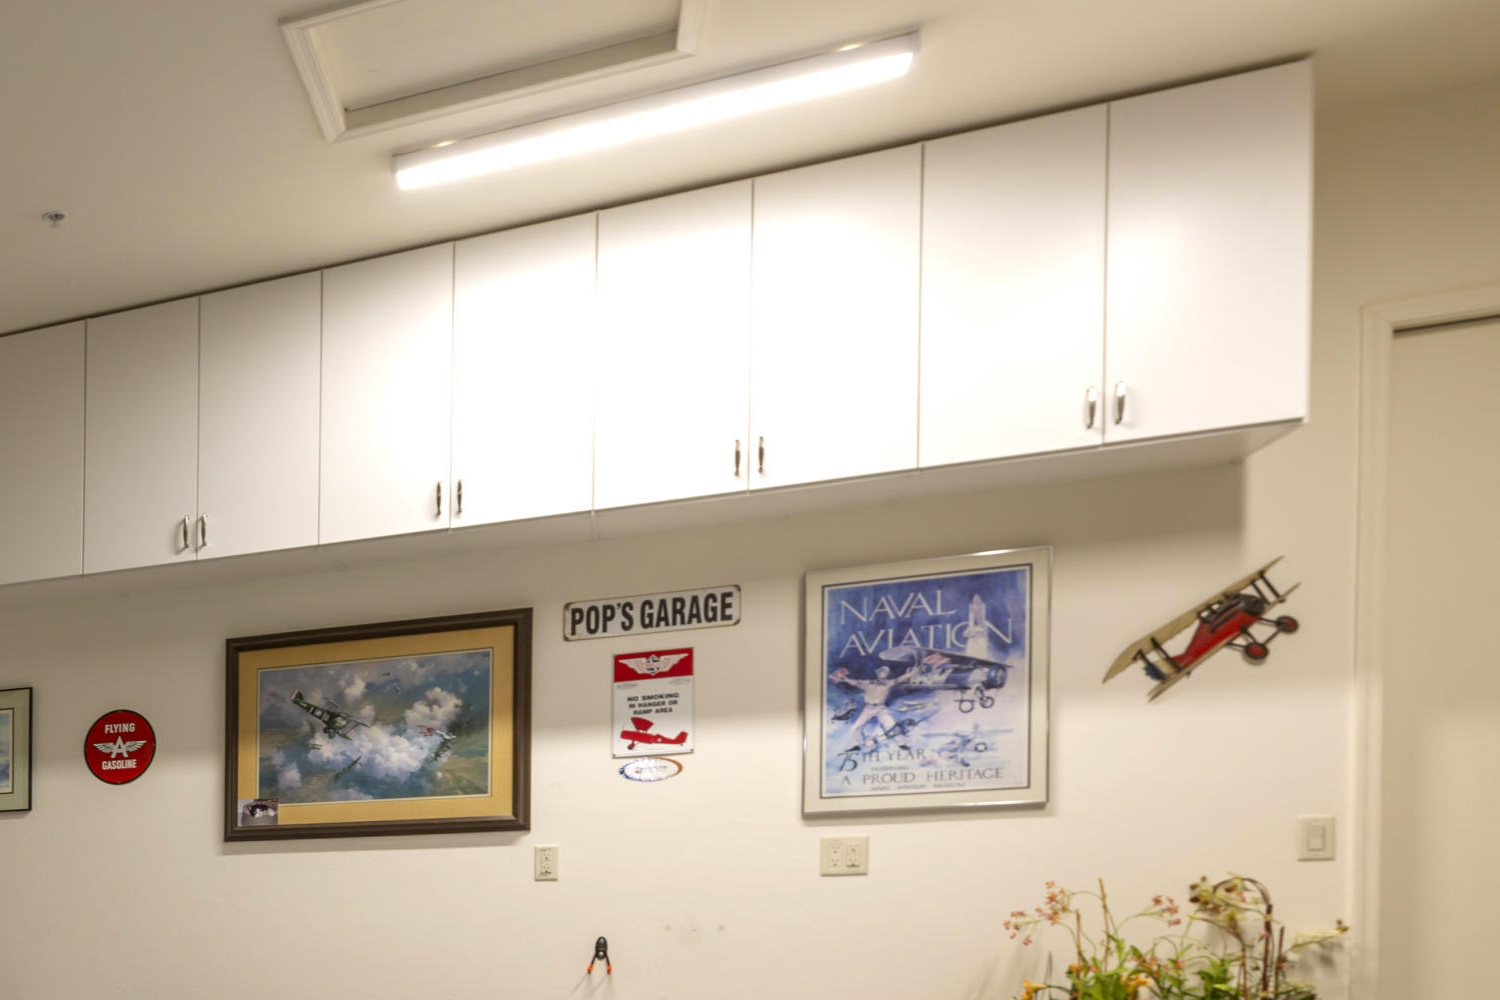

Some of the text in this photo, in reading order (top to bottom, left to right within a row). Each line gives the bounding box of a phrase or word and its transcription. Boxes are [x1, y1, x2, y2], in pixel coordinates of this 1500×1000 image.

[570, 591, 733, 636] POP'S GARAGE
[840, 589, 957, 625] NAVAL
[839, 617, 1013, 659] AVIATION
[642, 693, 680, 701] SMOKING
[104, 722, 136, 735] FLYING
[101, 759, 137, 770] GASOLINE
[885, 749, 927, 763] YEAR
[841, 766, 1005, 786] A PROUD HERITAGE
